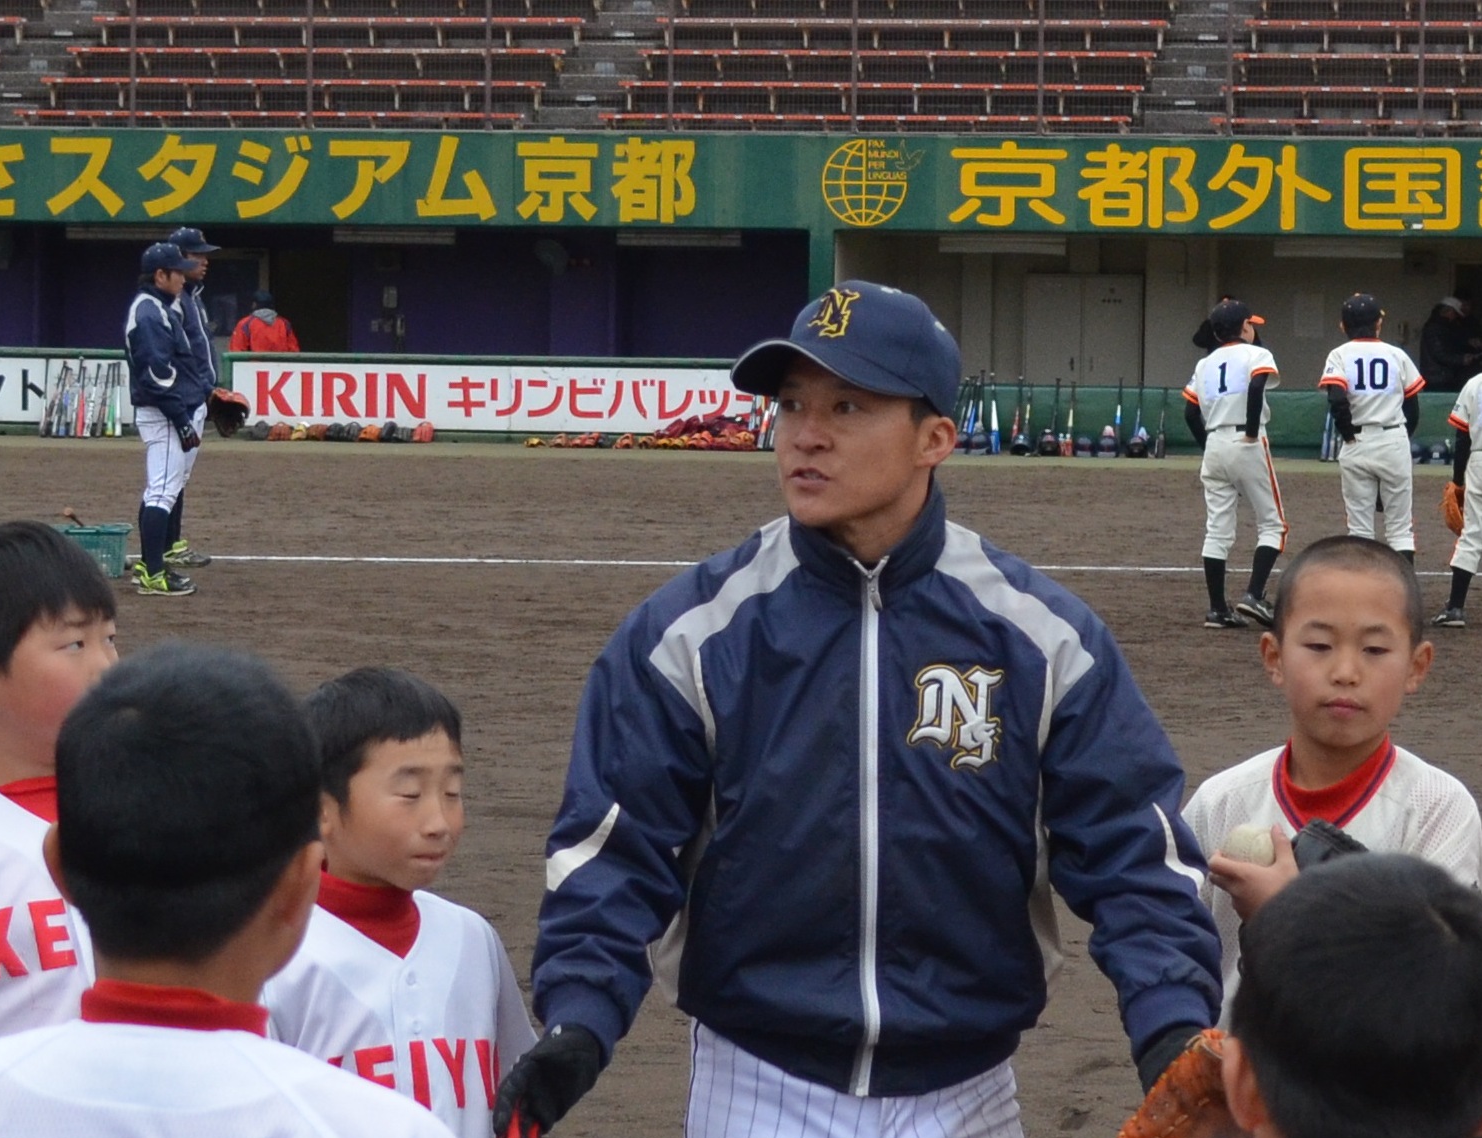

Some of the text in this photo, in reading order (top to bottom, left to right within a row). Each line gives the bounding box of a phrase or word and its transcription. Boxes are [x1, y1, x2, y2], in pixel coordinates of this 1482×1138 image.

[1218, 362, 1228, 394] 1
[1354, 358, 1389, 390] 10
[256, 370, 427, 419] KIRIN
